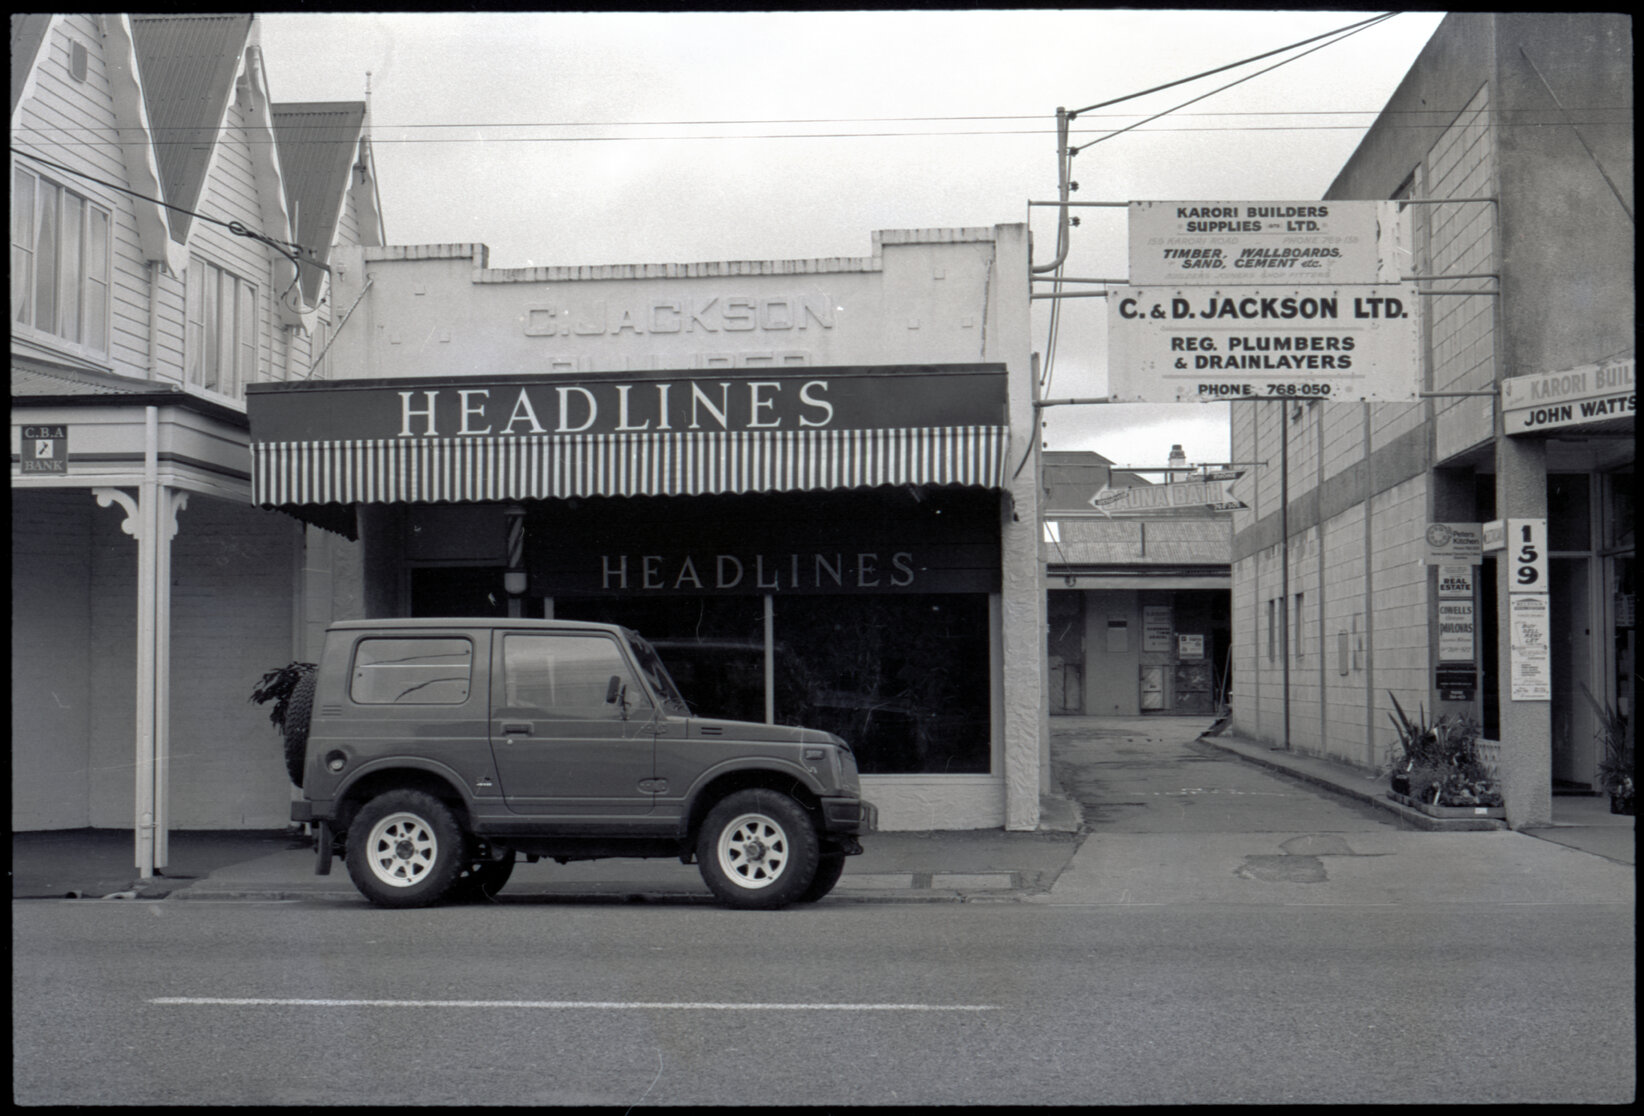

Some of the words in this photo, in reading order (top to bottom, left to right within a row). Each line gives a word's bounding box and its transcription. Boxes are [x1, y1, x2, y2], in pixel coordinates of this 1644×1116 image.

[1177, 207, 1238, 218] KARORI
[1247, 206, 1329, 218] BUILDERS
[1186, 221, 1262, 232] SUPPLIES
[1286, 221, 1320, 232] LTD.
[1167, 237, 1207, 246] KARORI
[1210, 237, 1239, 245] ROAD
[1282, 236, 1320, 244] PHONE
[1163, 249, 1228, 260] TIMBER,
[1240, 248, 1343, 259] WALLBOARDS,
[1182, 259, 1227, 270] SAND,
[1234, 258, 1299, 269] CEMENT
[1301, 259, 1322, 269] etc.
[1119, 298, 1146, 319] C.
[1150, 304, 1167, 319] &
[1172, 298, 1196, 319] D.
[1200, 298, 1338, 319] JACKSON
[1354, 298, 1408, 318] LTD.
[1171, 337, 1218, 352] REG.
[1229, 337, 1355, 351] PLUMBERS
[1174, 357, 1188, 369] &
[1195, 355, 1352, 370] DRAINLAYERS
[1198, 384, 1252, 396] PHONE
[1267, 383, 1331, 395] 768-050
[1531, 372, 1587, 400] KARORI
[398, 380, 836, 437] HEADLINES
[1524, 405, 1573, 427] JOHN
[1580, 396, 1636, 418] WATTS
[24, 460, 63, 471] BANK
[1172, 481, 1223, 506] BATH
[600, 552, 916, 590] HEADLINES
